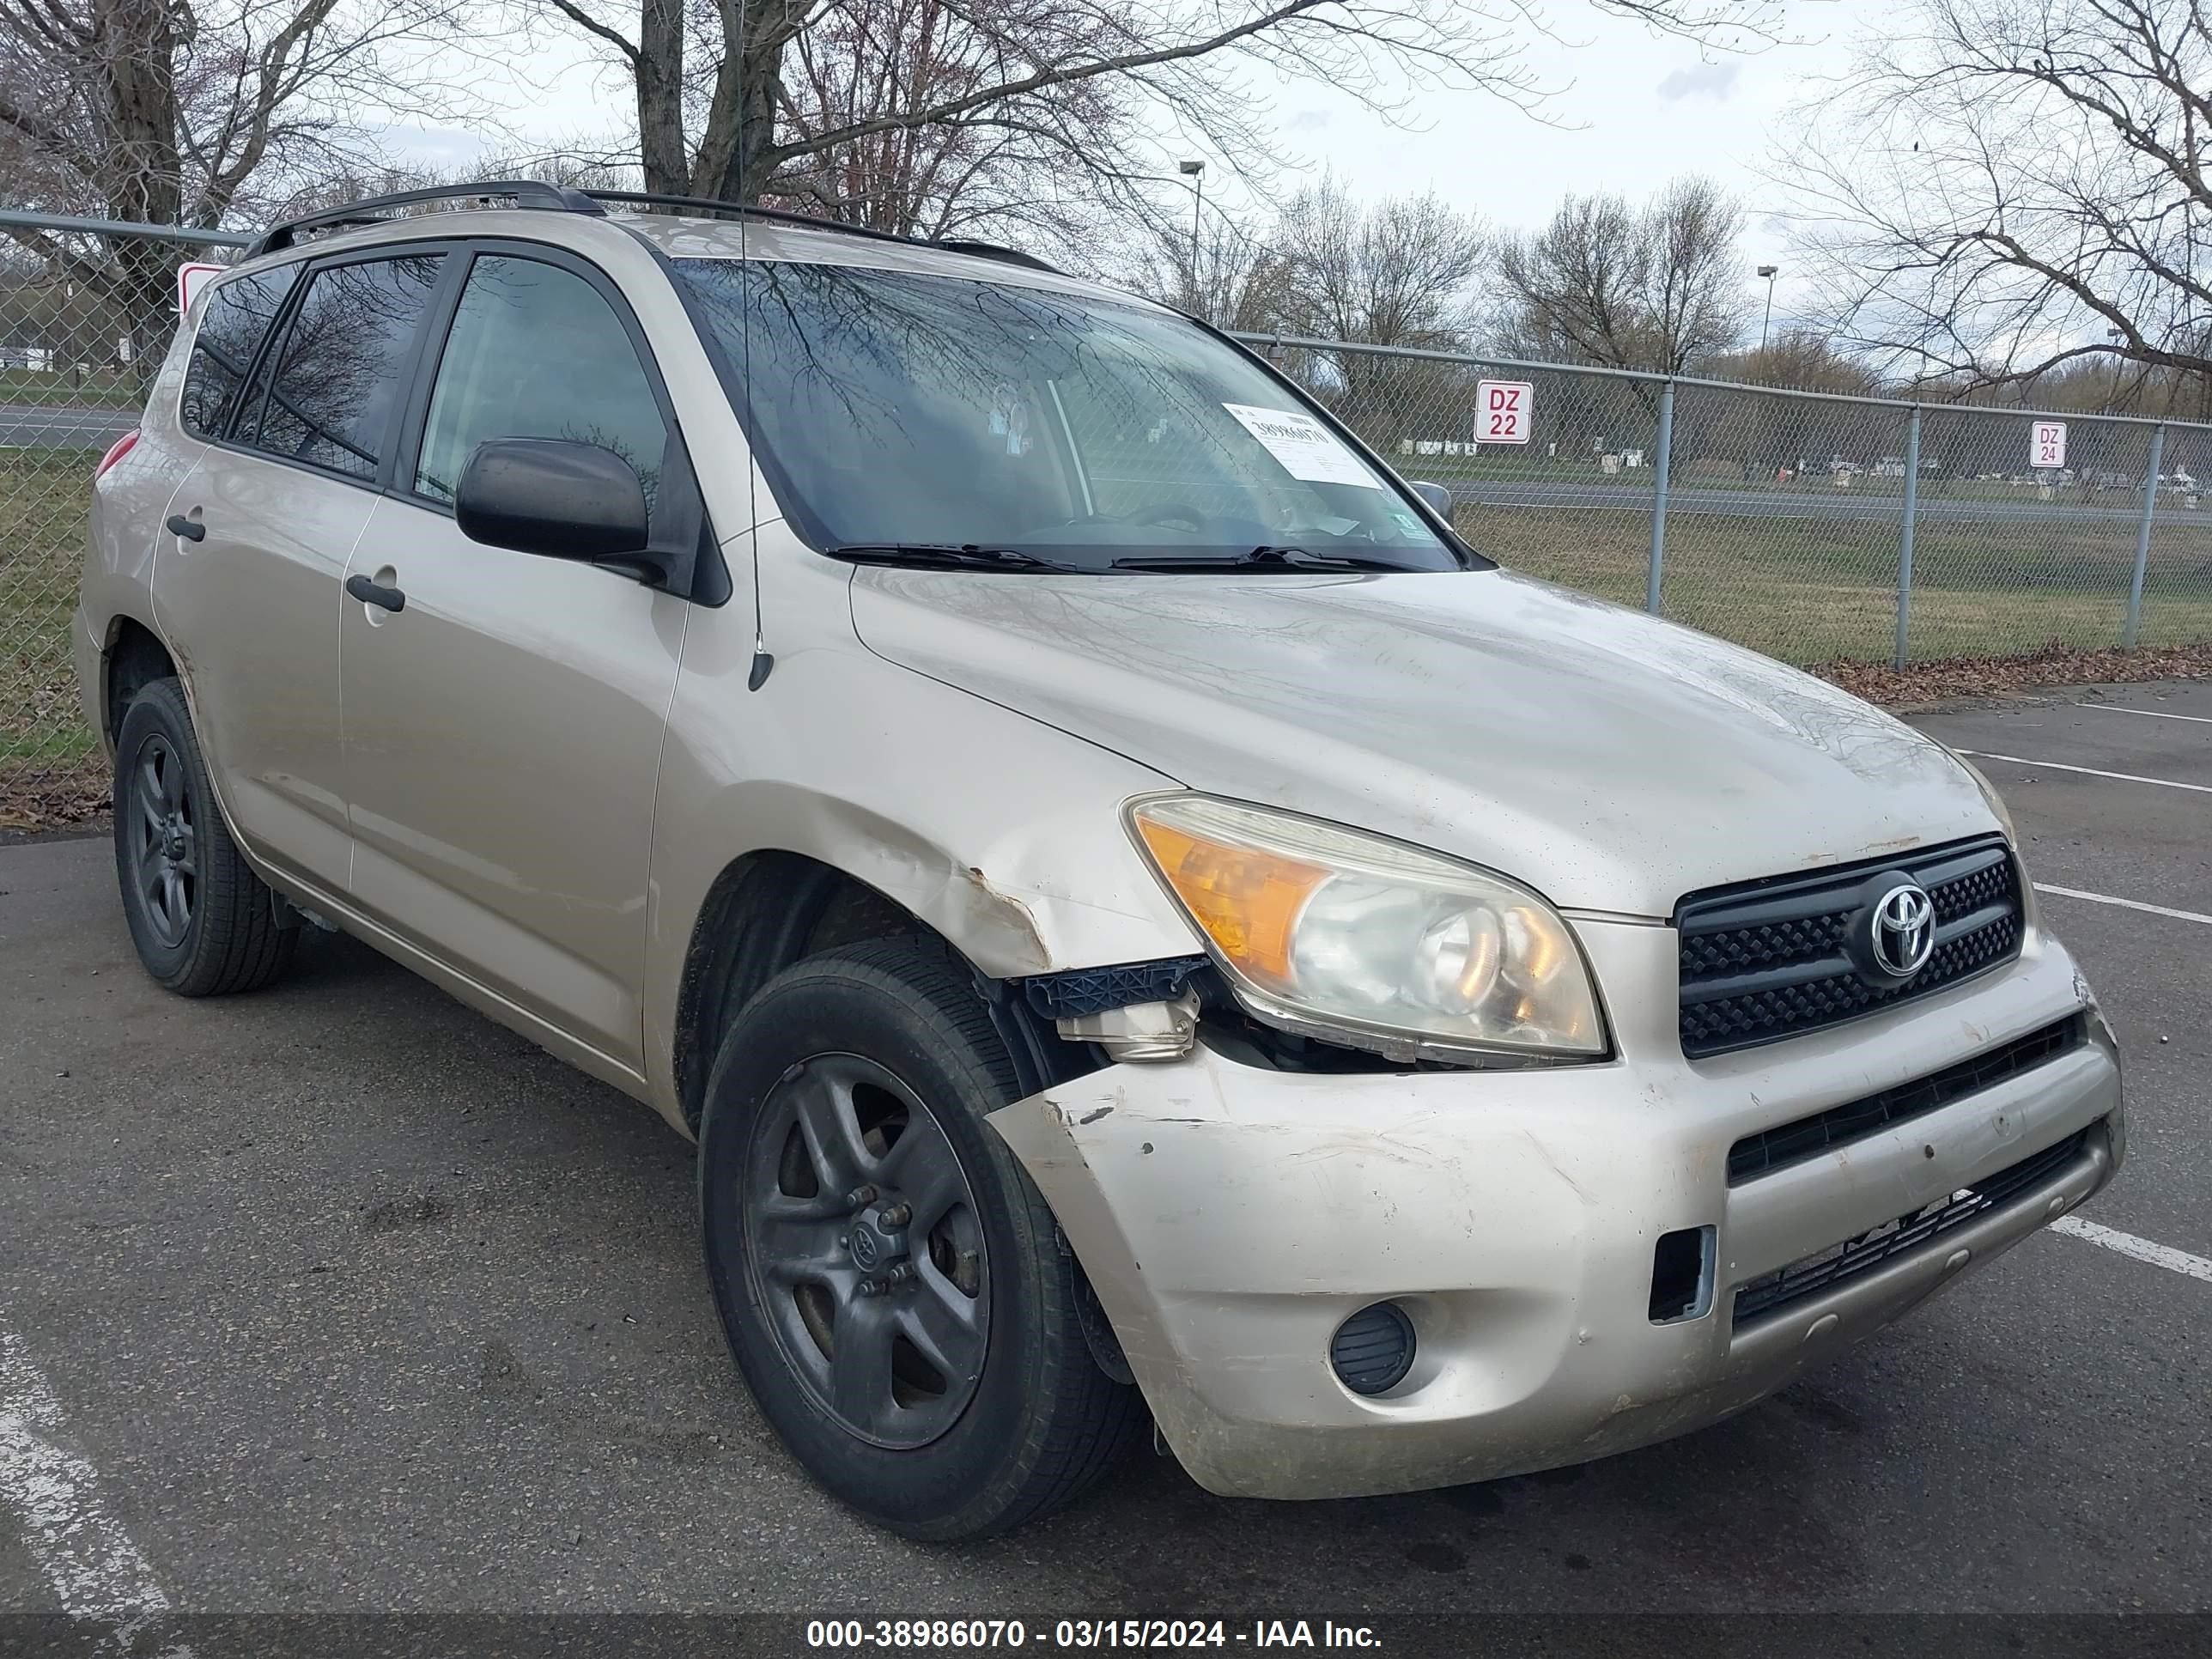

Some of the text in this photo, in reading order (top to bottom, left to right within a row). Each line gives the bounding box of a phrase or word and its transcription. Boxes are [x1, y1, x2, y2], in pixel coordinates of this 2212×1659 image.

[1490, 389, 1521, 411] DZ
[1490, 414, 1516, 435] 22
[2039, 428, 2059, 444] DZ
[2040, 447, 2056, 461] 24
